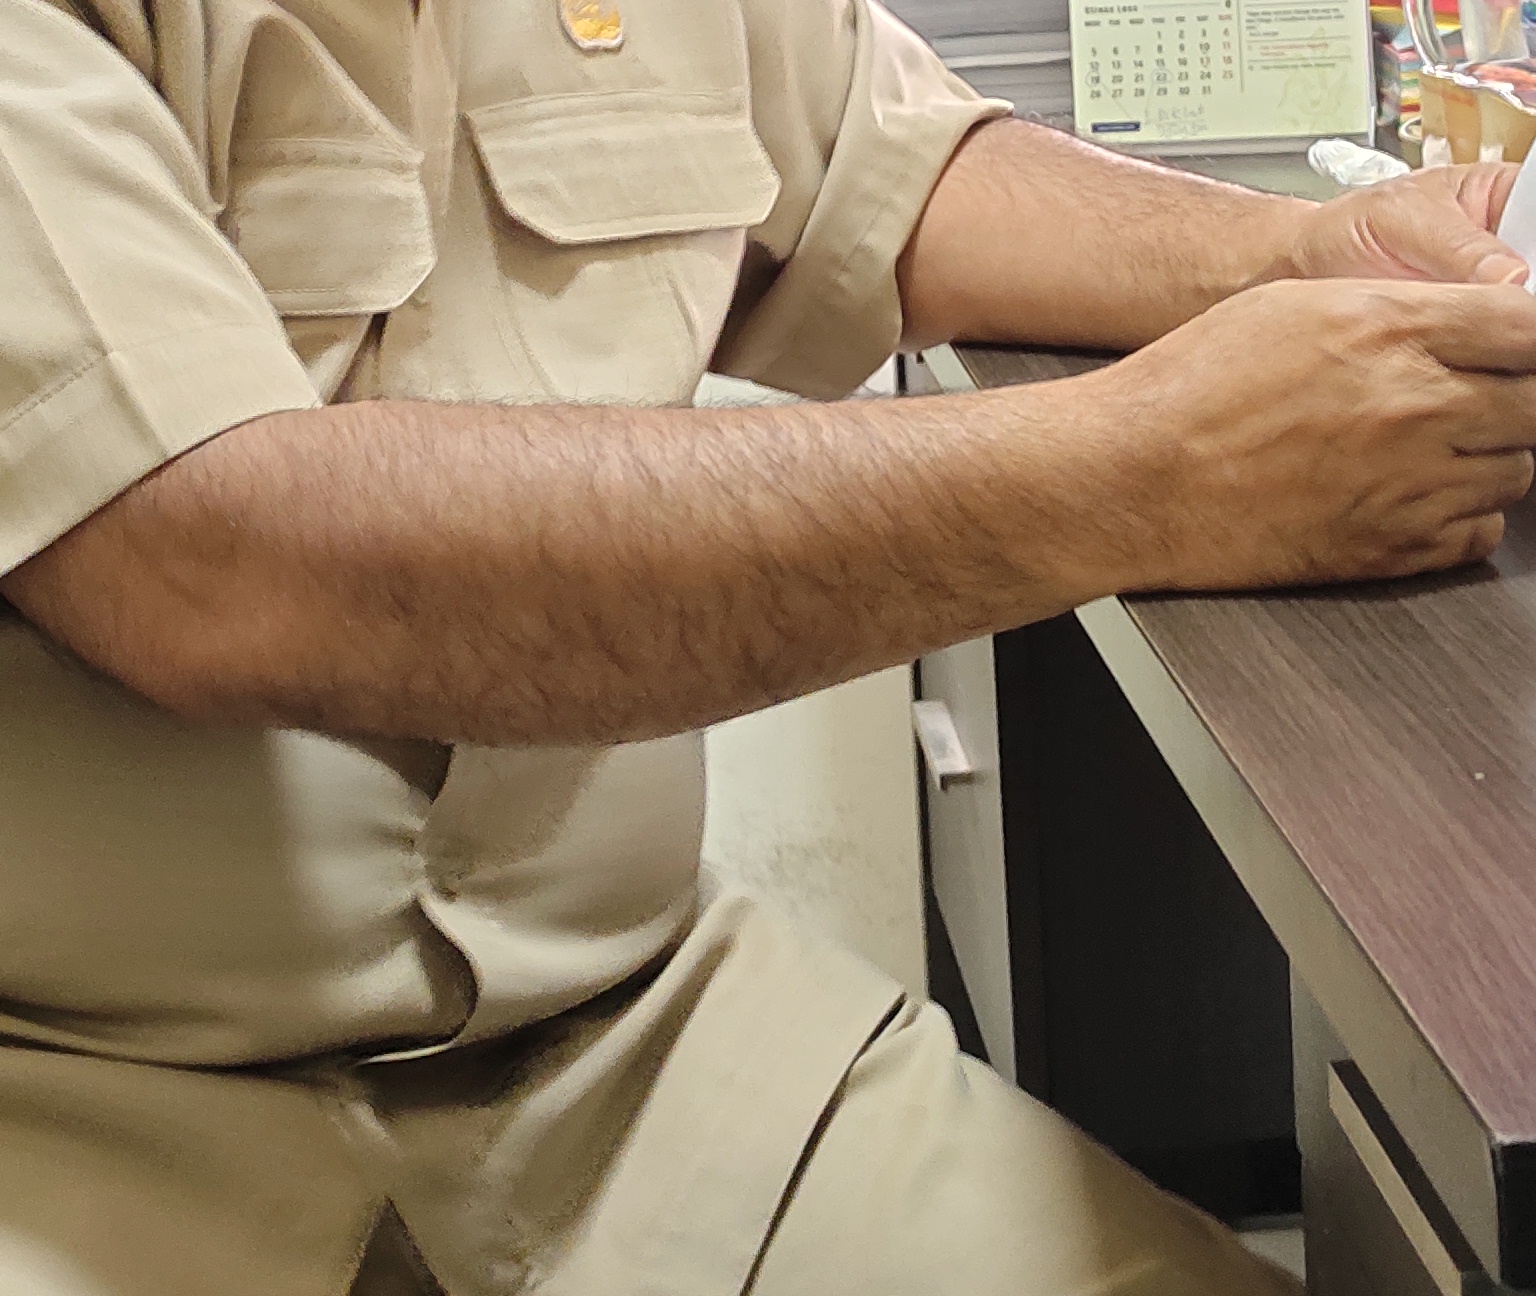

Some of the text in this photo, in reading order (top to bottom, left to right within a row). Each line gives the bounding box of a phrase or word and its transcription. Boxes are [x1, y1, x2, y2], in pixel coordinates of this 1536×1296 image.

[1178, 29, 1184, 39] 2
[1199, 42, 1210, 52] 10
[1222, 41, 1231, 50] 11
[1133, 59, 1144, 68] 14
[1111, 74, 1123, 84] 20
[1134, 73, 1144, 83] 21
[1177, 71, 1189, 81] 23
[1199, 70, 1211, 80] 24
[1222, 69, 1234, 80] 25
[1111, 88, 1123, 99] 27
